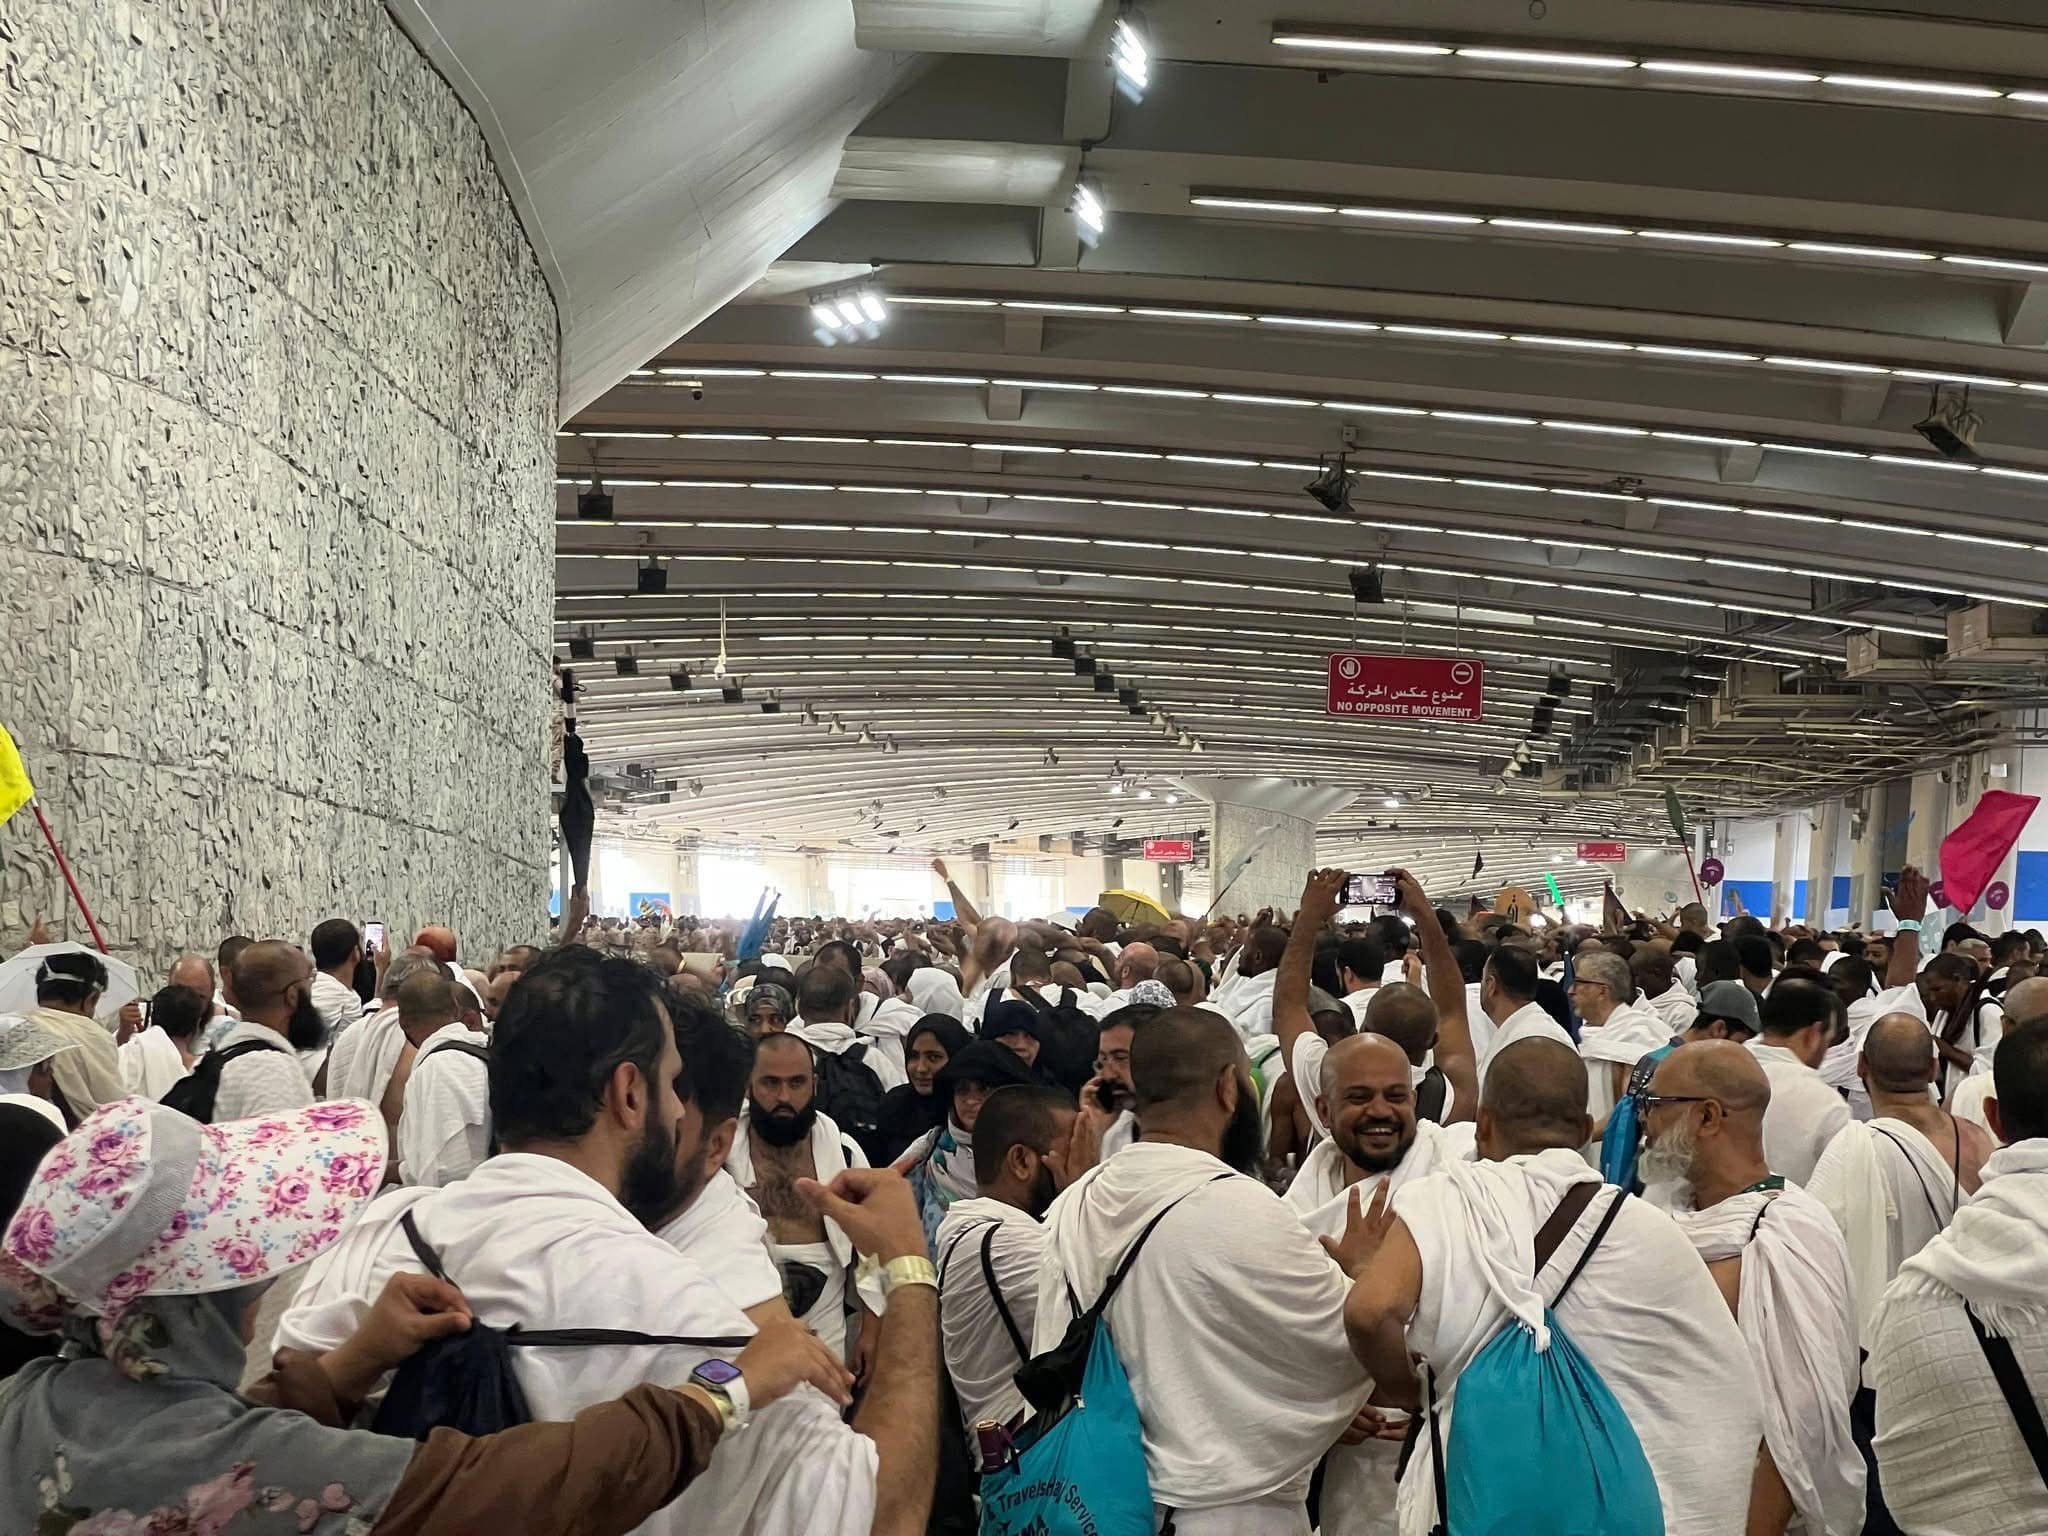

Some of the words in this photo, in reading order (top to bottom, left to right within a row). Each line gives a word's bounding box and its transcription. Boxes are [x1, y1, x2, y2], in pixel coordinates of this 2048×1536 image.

[1347, 682, 1387, 698] الحركة
[1391, 686, 1429, 699] عكس
[1337, 701, 1353, 711] NO
[1356, 702, 1409, 714] OPPOSITE
[1412, 705, 1472, 717] MOVEMENT
[997, 1480, 1047, 1512] Travels
